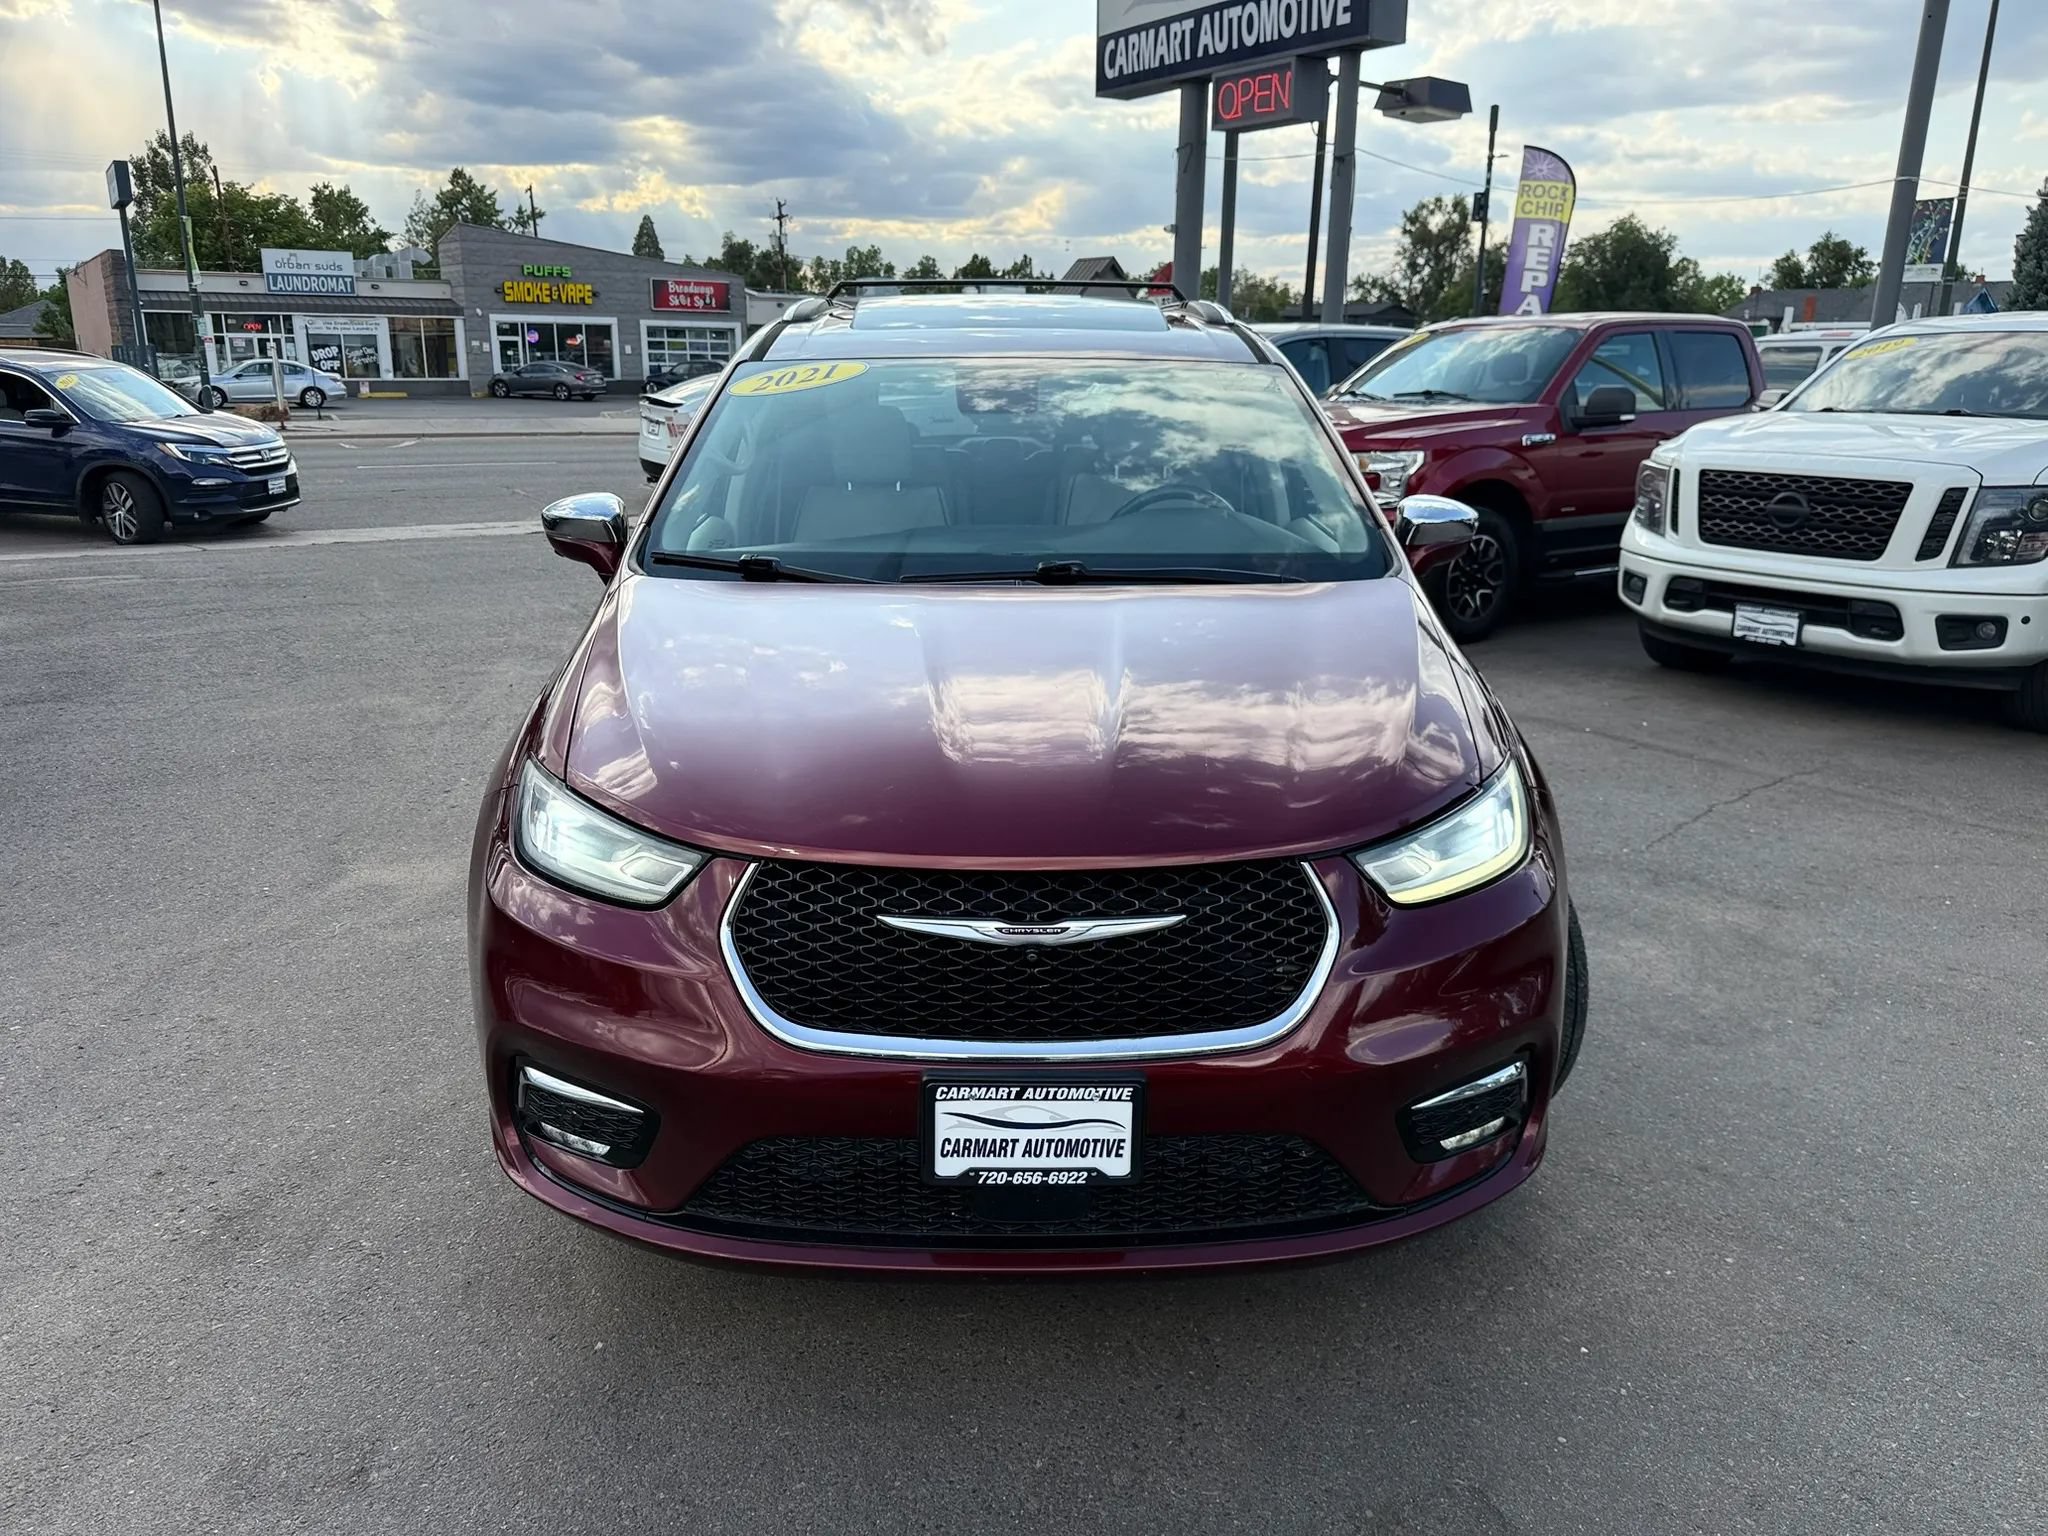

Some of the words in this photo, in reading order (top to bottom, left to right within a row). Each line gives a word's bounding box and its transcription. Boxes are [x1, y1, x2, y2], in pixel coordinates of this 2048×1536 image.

[1104, 18, 1194, 79] CARMART
[1197, 0, 1351, 58] AUTOMOTIVE
[1218, 71, 1292, 119] OPEN
[1520, 183, 1569, 201] ROCK
[1520, 200, 1565, 217] CHIP
[315, 261, 343, 271] suds
[523, 264, 571, 277] PUFFS
[269, 275, 352, 292] LAUNDROMAT
[503, 281, 551, 303] SMOKE
[559, 284, 593, 304] VAPE
[311, 346, 338, 361] DROP
[320, 361, 340, 370] OFF
[751, 363, 839, 392] 2021
[935, 1087, 1020, 1100] CARMART
[1023, 1087, 1133, 1100] AUTOMOTIVE
[940, 1137, 1019, 1158] CARMART
[1021, 1138, 1126, 1158] AUTOMOTIVE
[978, 1171, 1088, 1184] 720-656-6922
